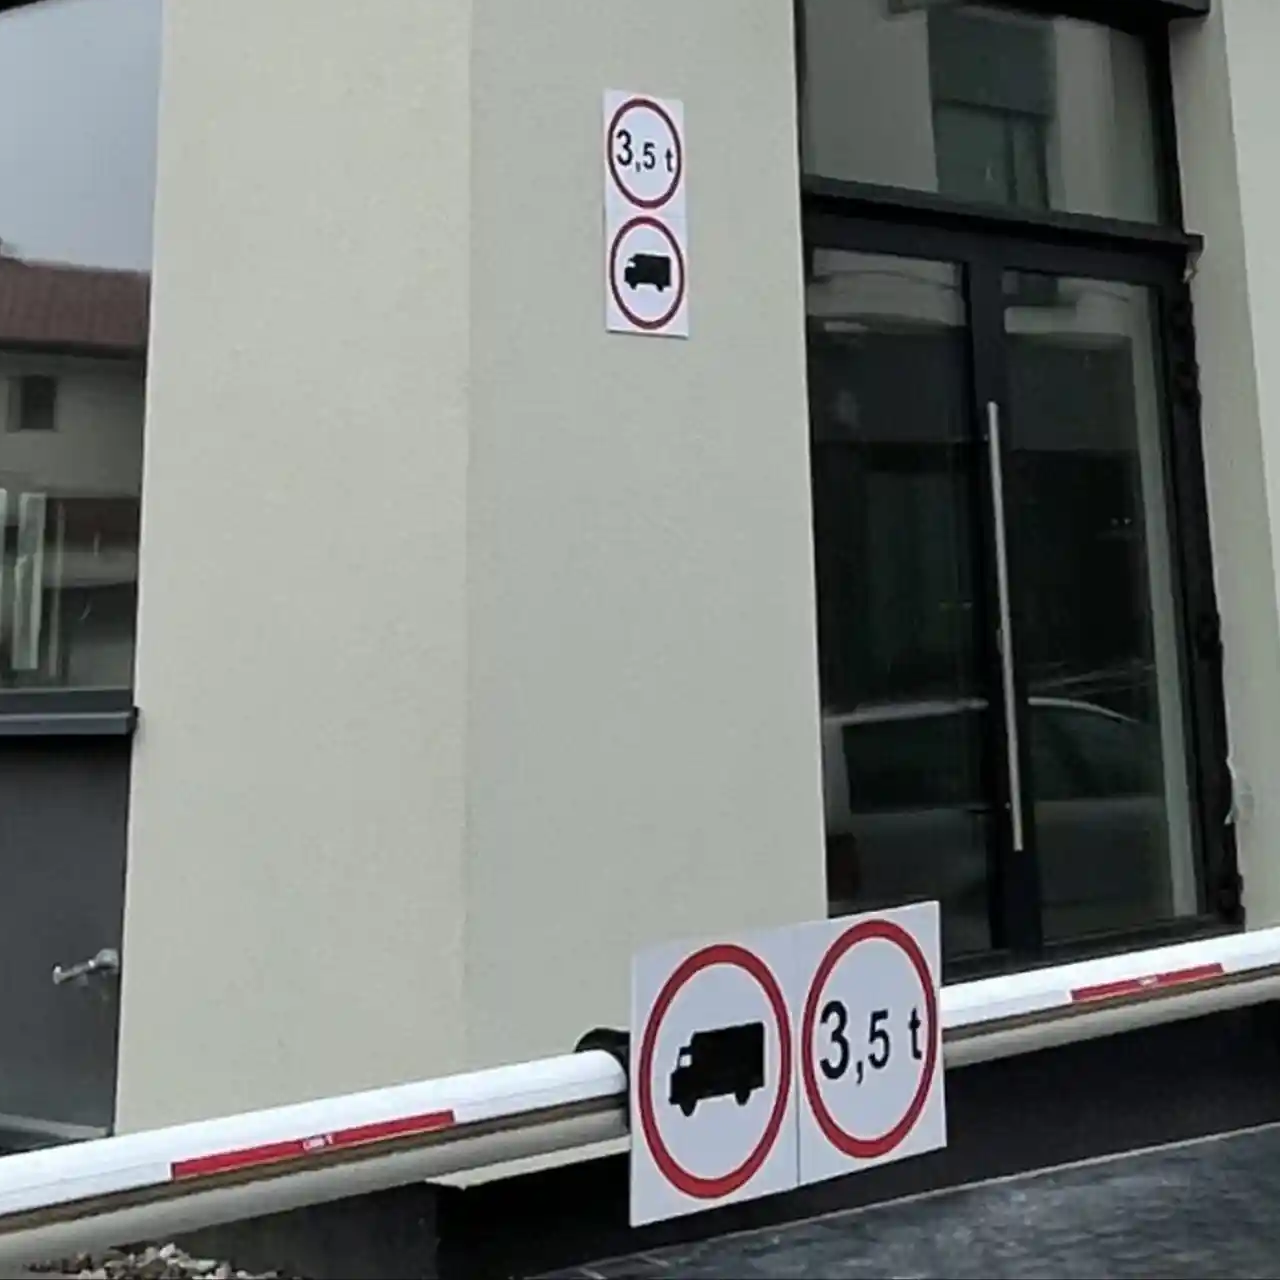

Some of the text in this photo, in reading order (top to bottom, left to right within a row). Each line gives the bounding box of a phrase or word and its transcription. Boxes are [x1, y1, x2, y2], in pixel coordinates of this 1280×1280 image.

[616, 129, 674, 173] 3,5 t
[820, 1000, 922, 1085] 3,5 t
